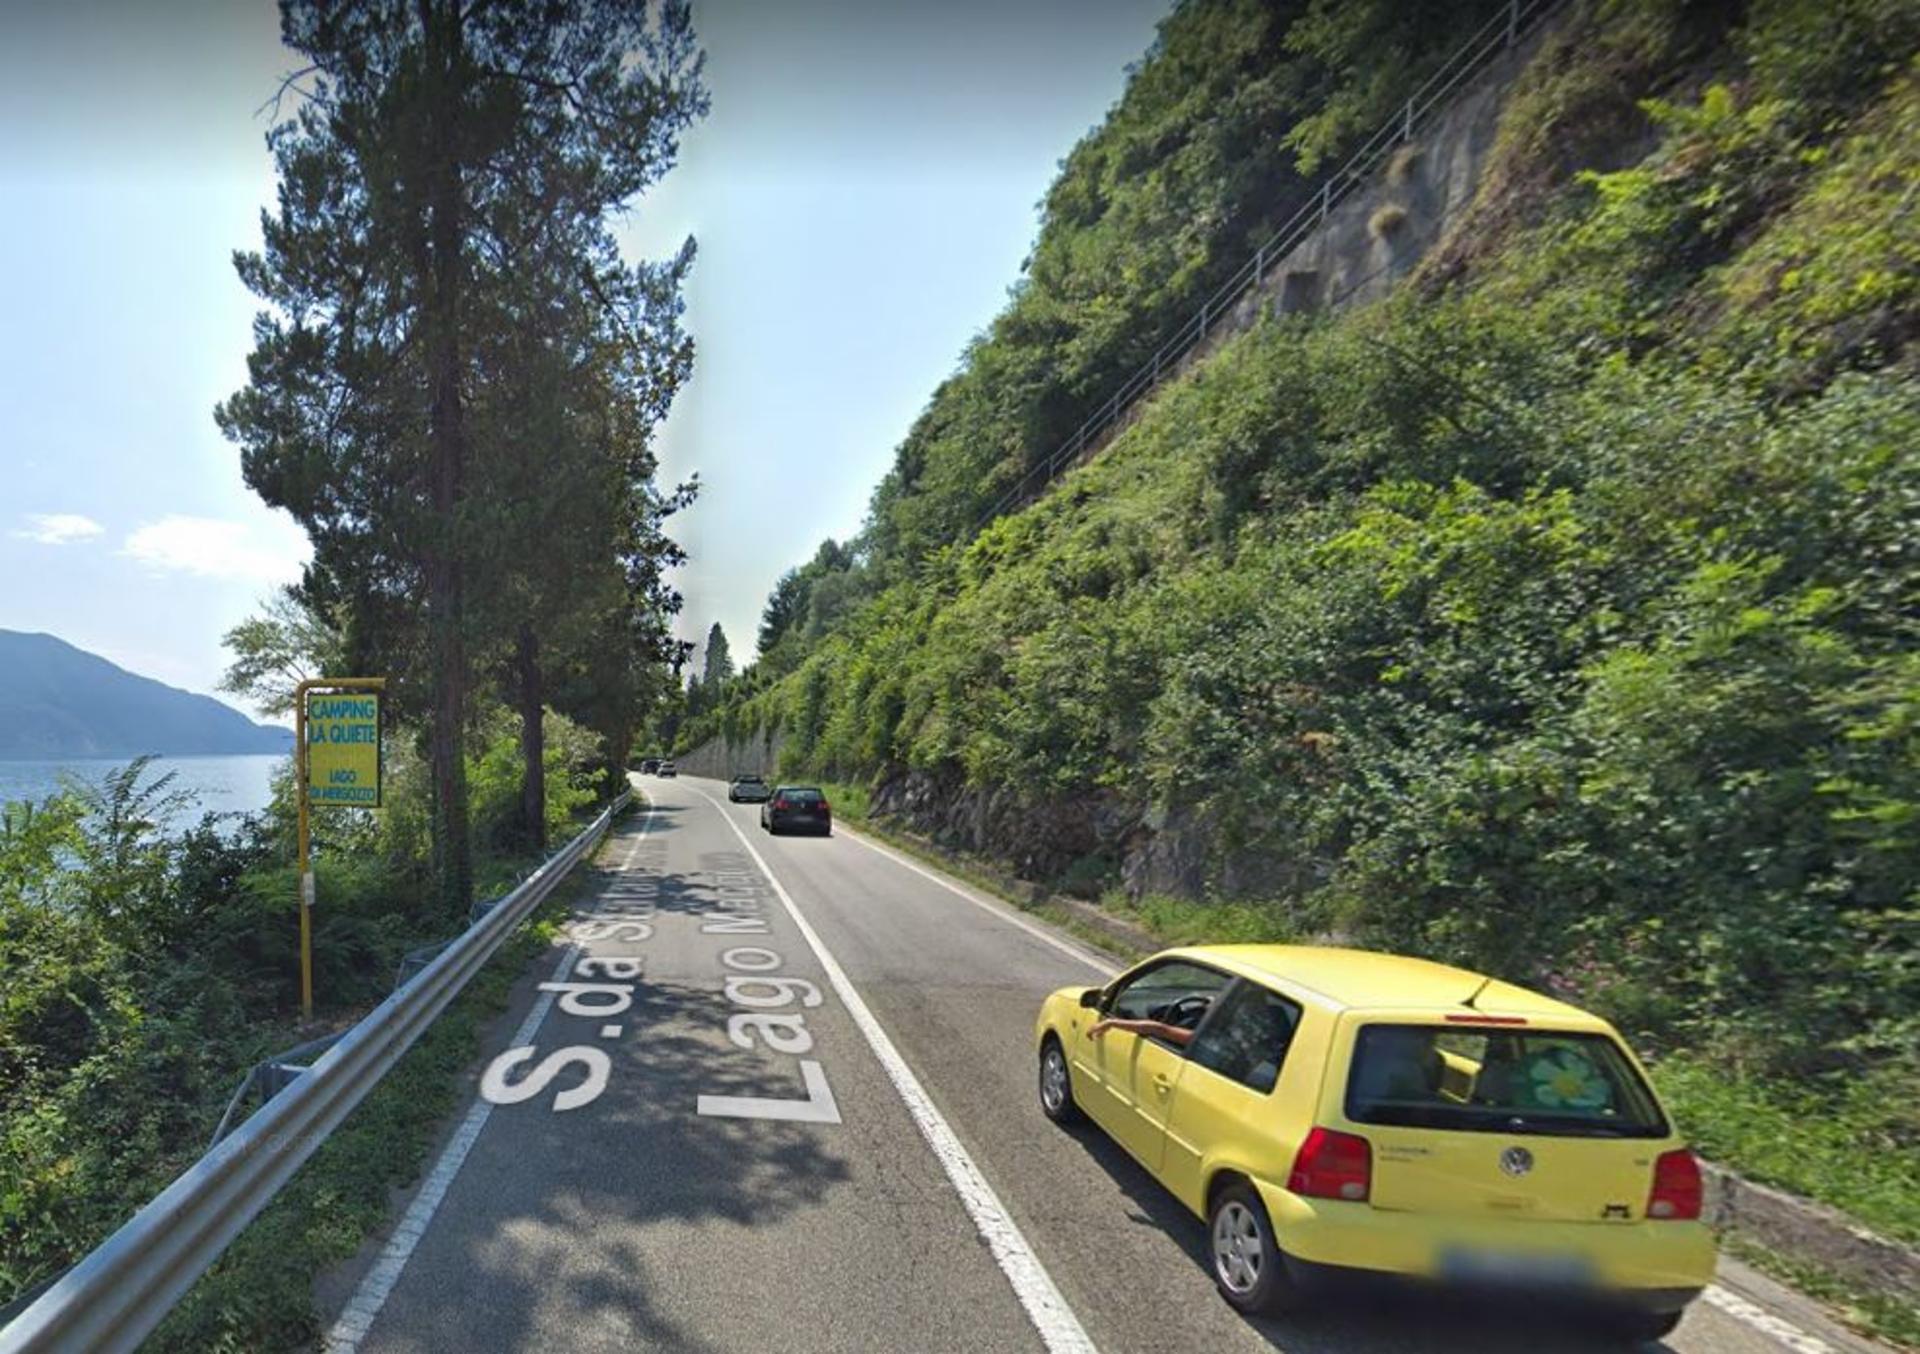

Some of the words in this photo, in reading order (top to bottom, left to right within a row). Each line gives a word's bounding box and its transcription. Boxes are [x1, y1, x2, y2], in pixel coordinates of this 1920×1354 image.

[310, 701, 376, 719] CAMPING
[309, 724, 327, 743] LA
[330, 724, 375, 744] QUIETE
[329, 769, 357, 784] LAGO
